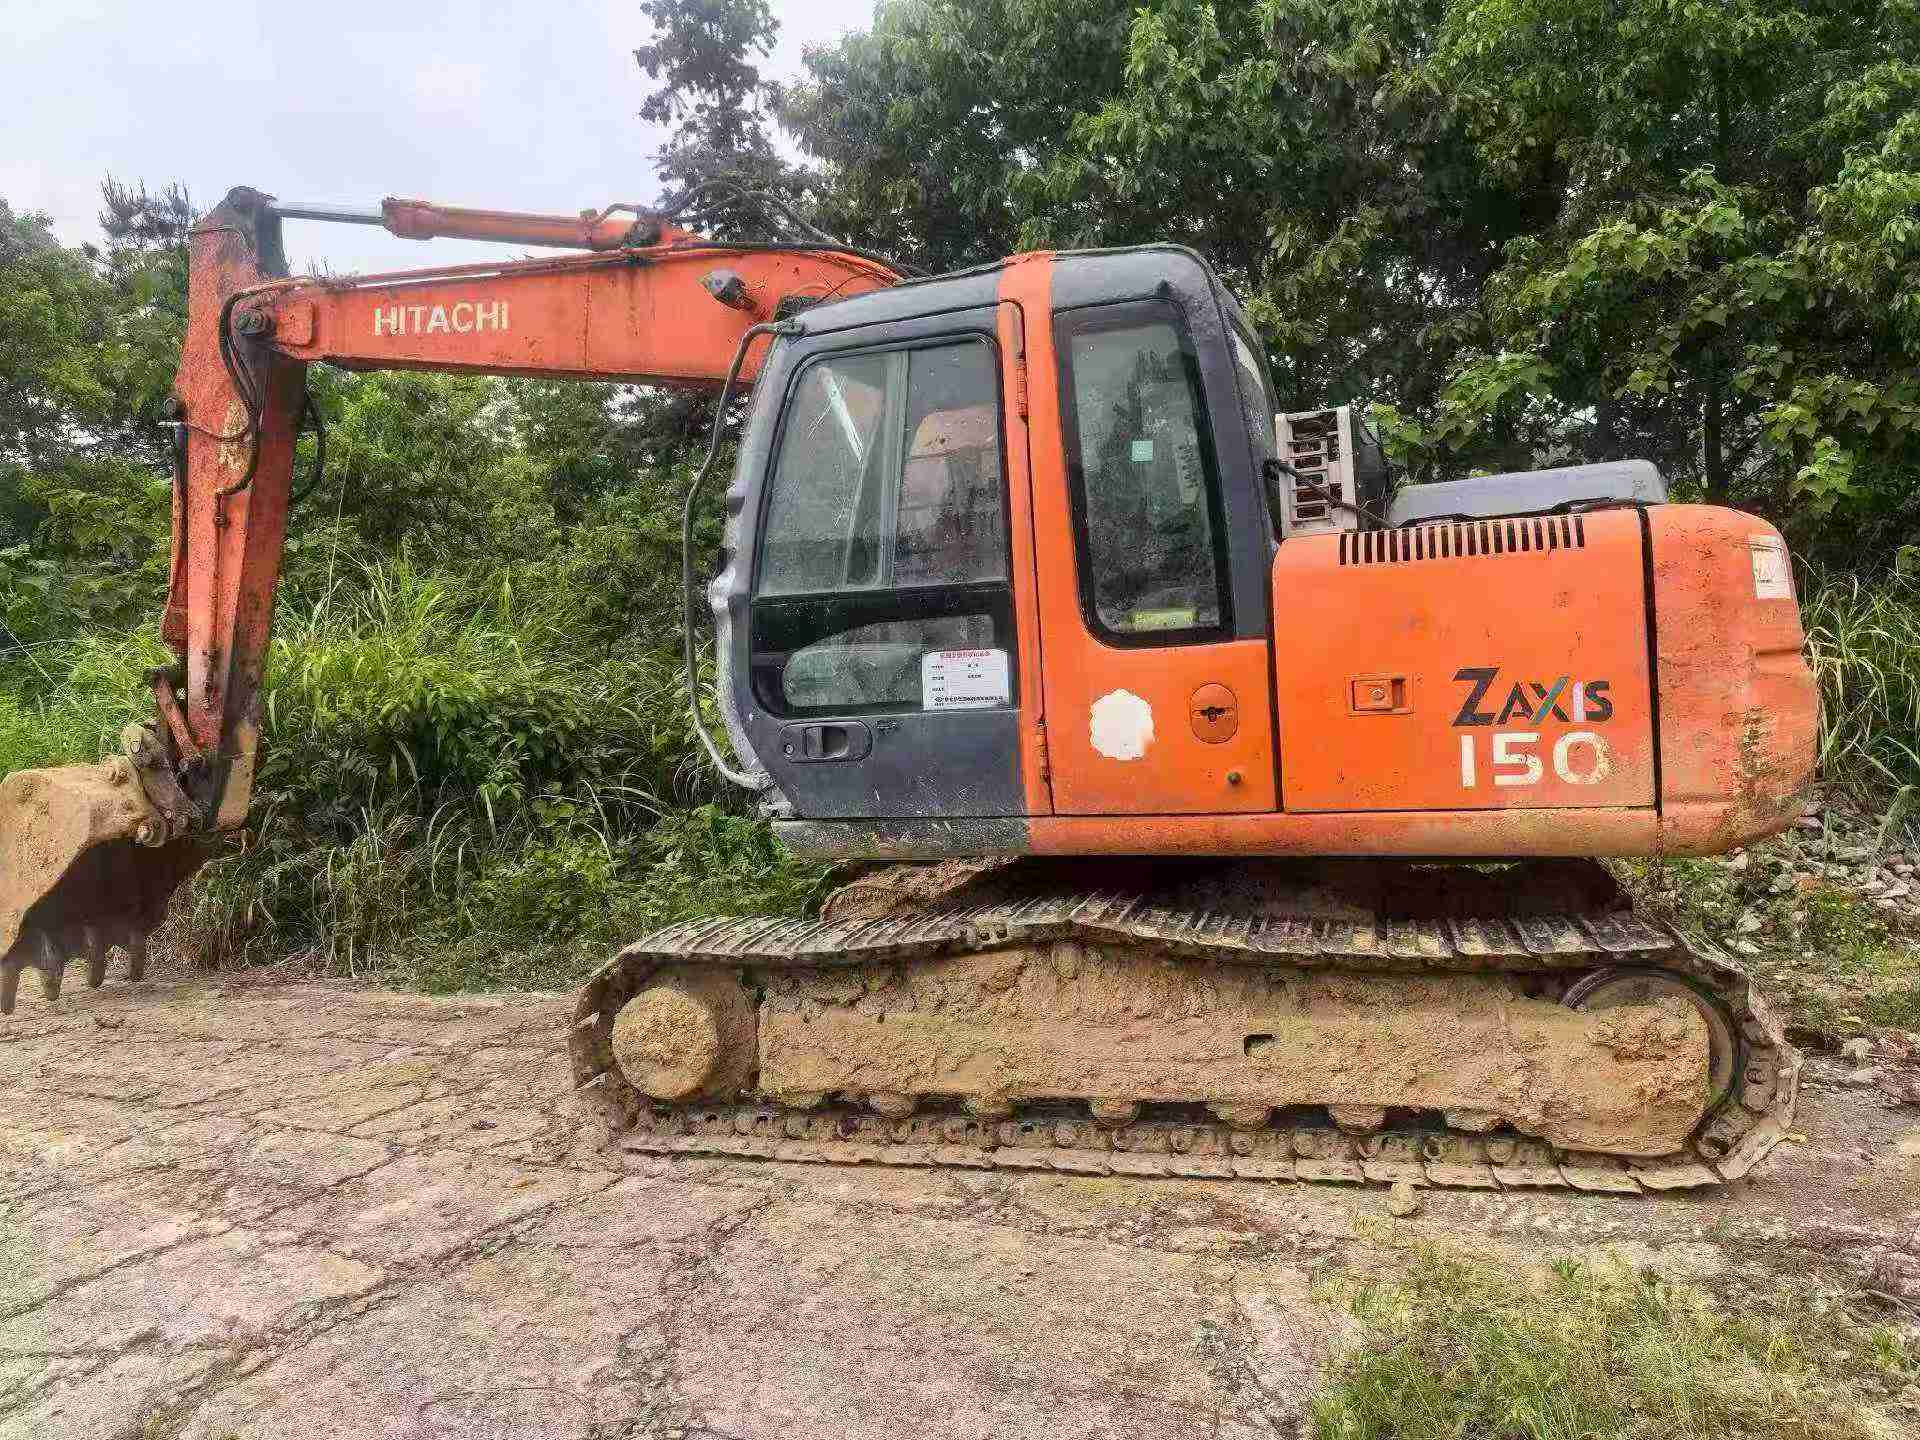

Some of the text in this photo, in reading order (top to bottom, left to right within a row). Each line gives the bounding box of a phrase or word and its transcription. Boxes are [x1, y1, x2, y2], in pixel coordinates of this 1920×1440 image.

[374, 302, 509, 335] HITACHI
[1452, 667, 1615, 726] ZAXIS
[1460, 731, 1611, 788] 150
